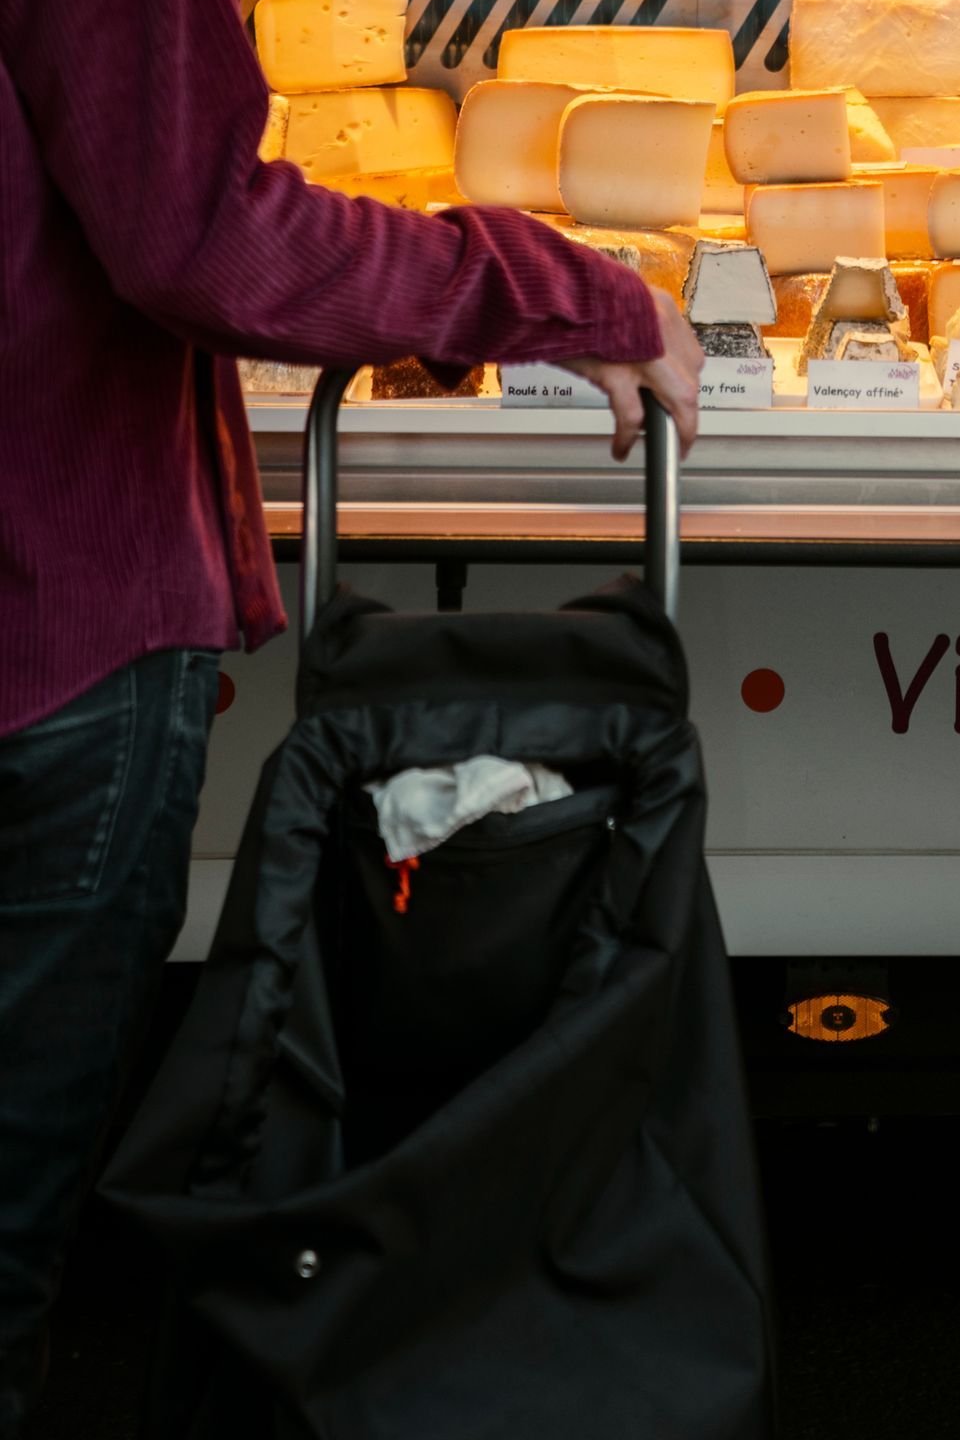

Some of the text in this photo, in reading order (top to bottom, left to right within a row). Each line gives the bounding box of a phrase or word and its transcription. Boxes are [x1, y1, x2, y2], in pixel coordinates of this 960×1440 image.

[508, 385, 572, 396] Roulé à l'ail
[719, 382, 746, 394] frais
[813, 385, 900, 398] Valençay affiné
